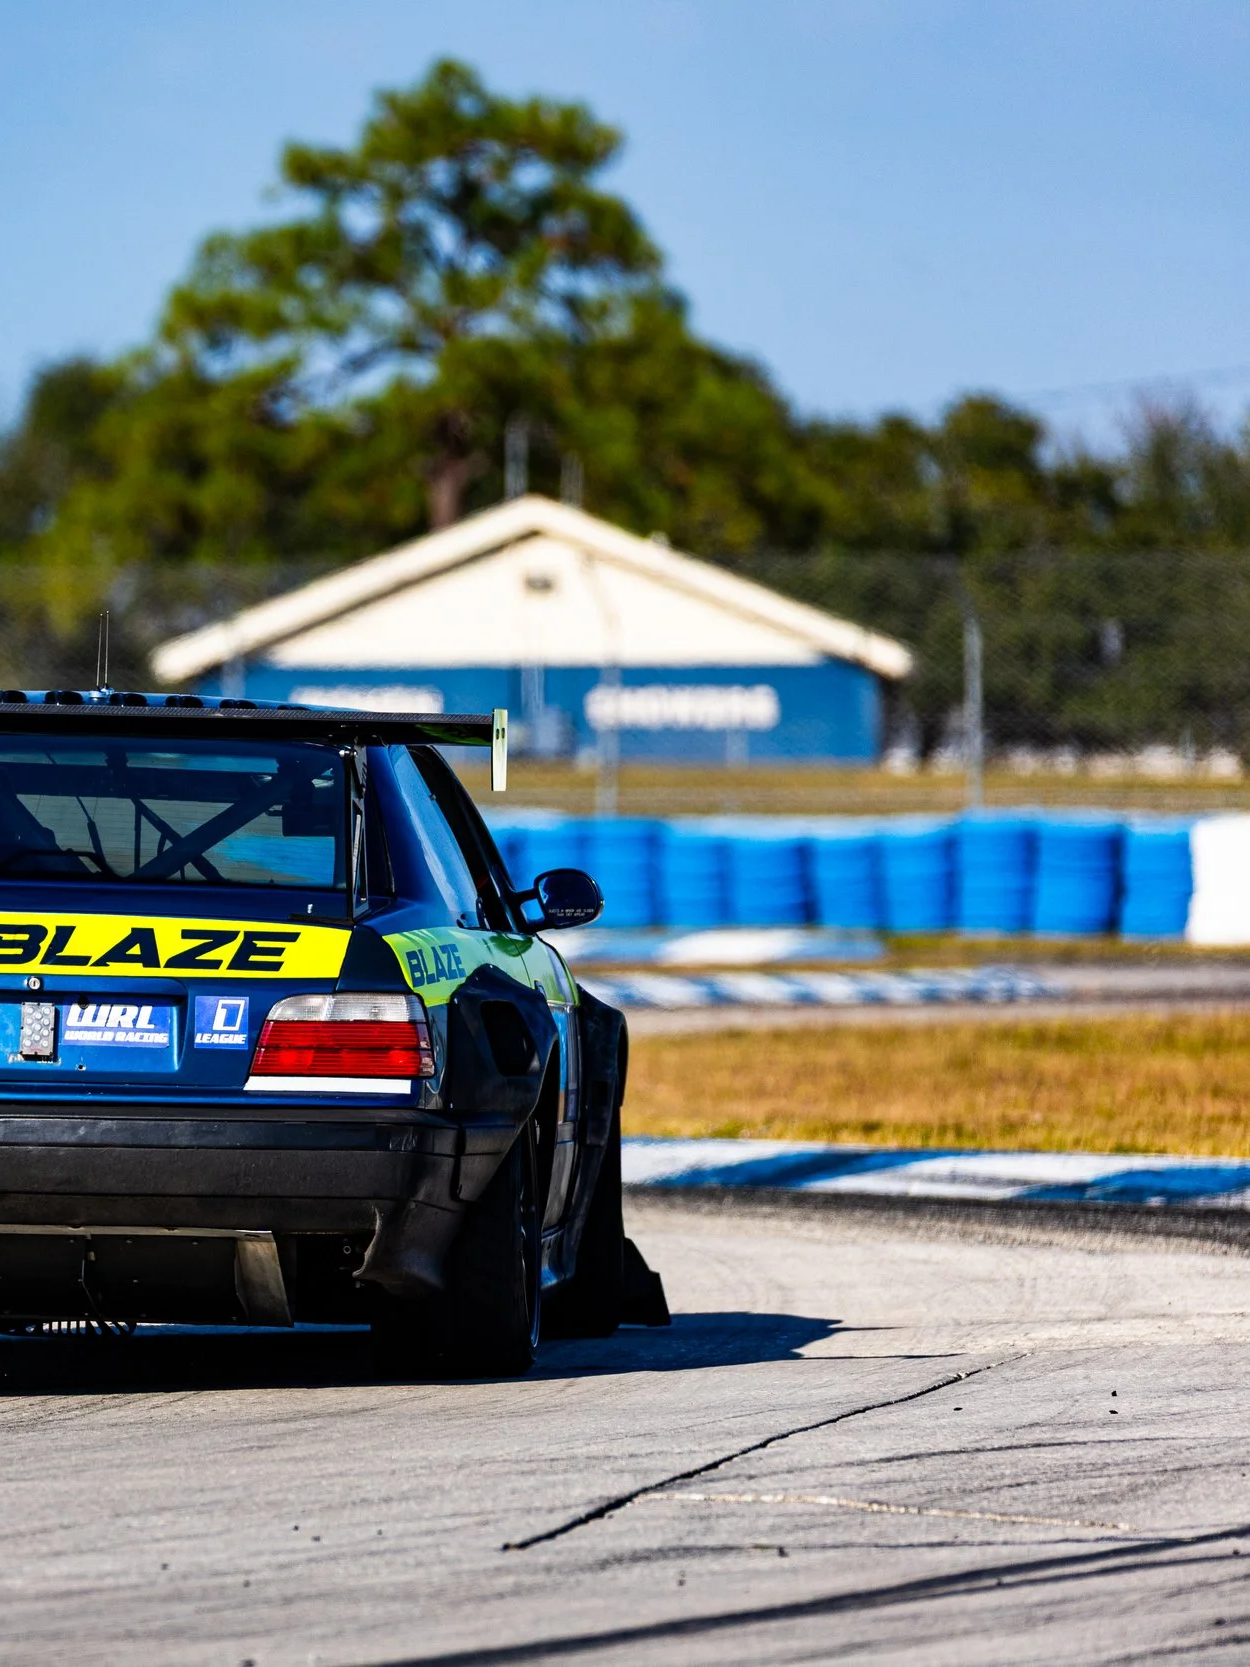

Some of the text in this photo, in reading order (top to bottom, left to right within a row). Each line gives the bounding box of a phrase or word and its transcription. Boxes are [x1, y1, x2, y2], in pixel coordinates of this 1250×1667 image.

[406, 944, 466, 988] BLAZE
[66, 1003, 155, 1029] WRL
[64, 1030, 168, 1044] WORLD RACING
[195, 1032, 247, 1044] LEAGUE
